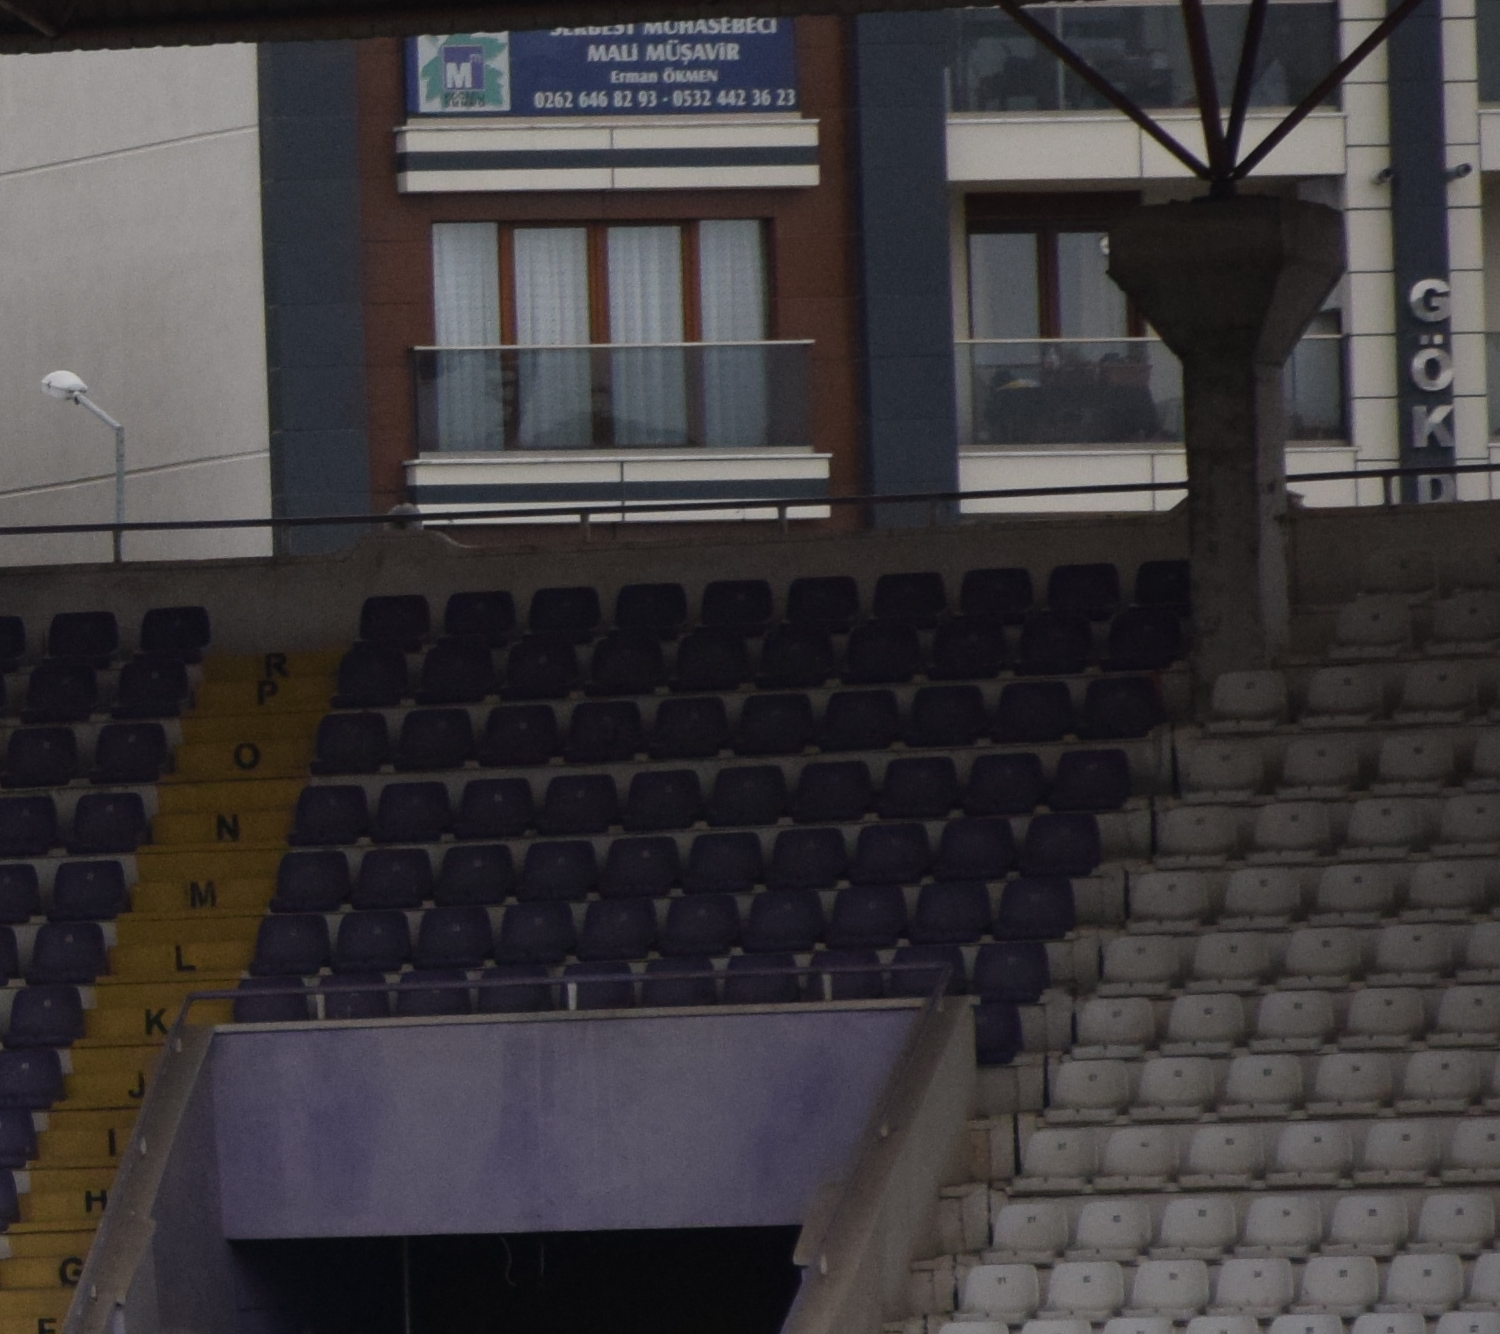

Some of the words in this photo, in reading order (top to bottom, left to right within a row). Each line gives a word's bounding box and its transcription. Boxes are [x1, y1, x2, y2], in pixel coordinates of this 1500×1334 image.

[610, 70, 658, 83] Erman
[534, 91, 574, 108] 0262
[579, 91, 608, 108] 646
[613, 91, 633, 108] 82
[638, 91, 657, 107] 93
[672, 90, 712, 107] 0532
[717, 90, 746, 106] 442
[752, 90, 771, 106] 36
[777, 89, 796, 106] 23
[217, 814, 240, 841] N
[189, 881, 217, 908] M
[175, 946, 196, 973] L
[145, 1009, 168, 1035] K
